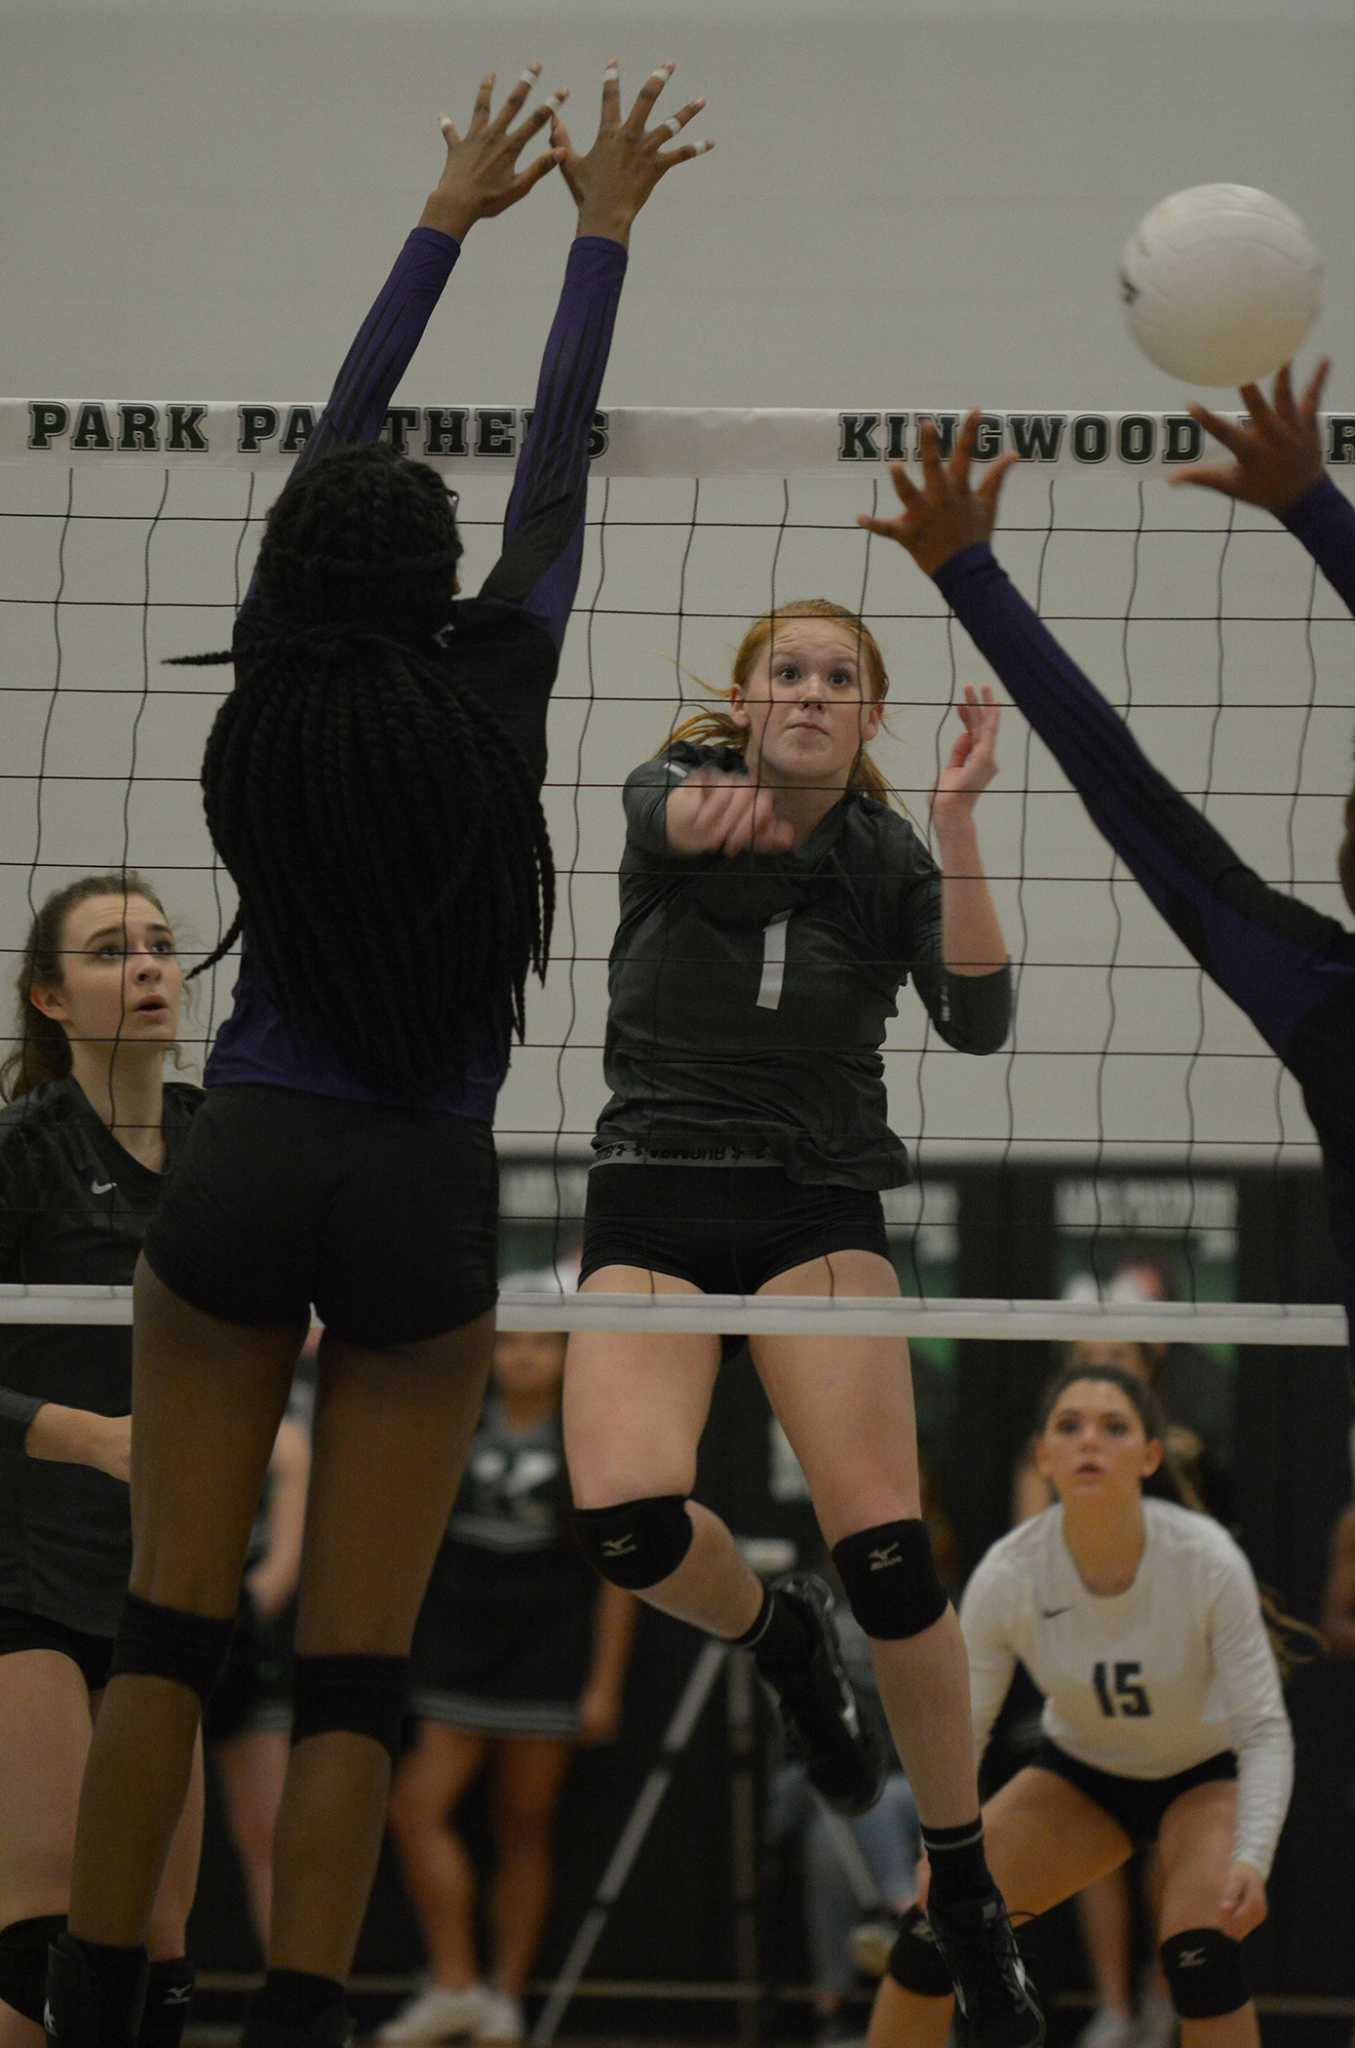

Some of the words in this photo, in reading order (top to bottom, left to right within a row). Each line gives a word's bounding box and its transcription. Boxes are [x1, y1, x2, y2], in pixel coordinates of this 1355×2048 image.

[28, 402, 208, 452] PARK
[756, 910, 792, 1010] 1
[1094, 1662, 1151, 1717] 15
